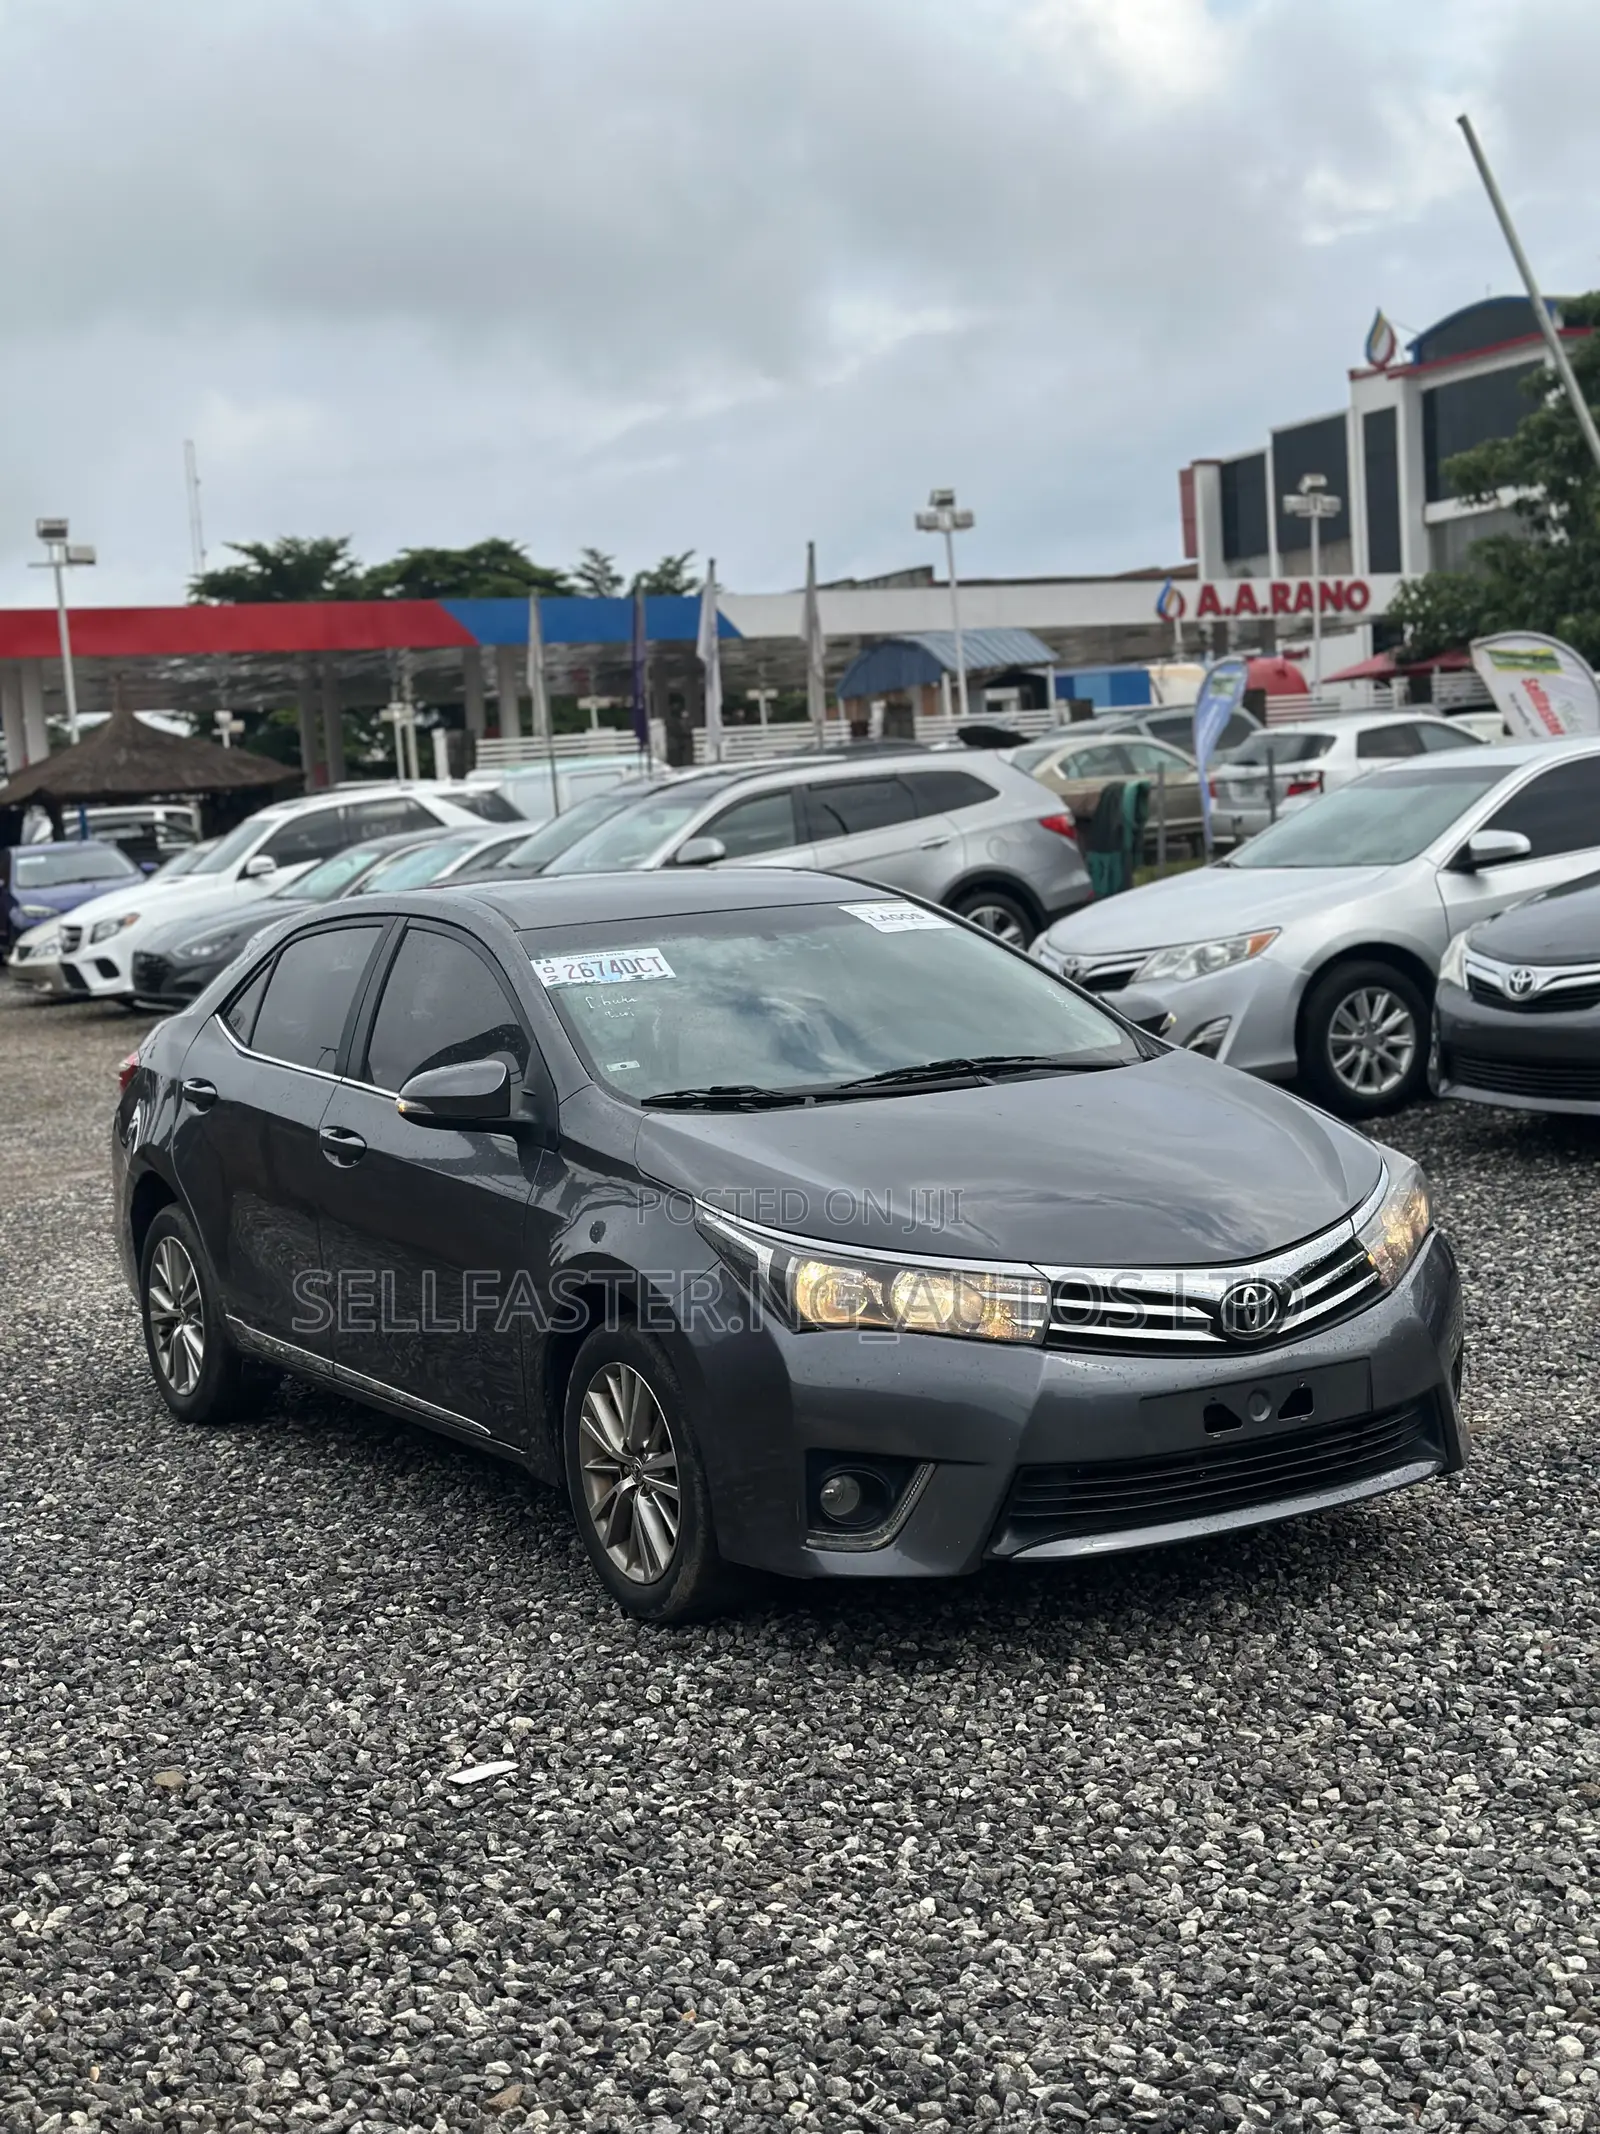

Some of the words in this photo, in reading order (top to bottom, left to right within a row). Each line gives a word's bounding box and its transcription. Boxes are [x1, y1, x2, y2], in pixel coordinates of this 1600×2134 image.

[1197, 579, 1371, 617] A.A.RANO
[867, 912, 925, 922] LAGOS
[563, 956, 665, 980] 2674DCT
